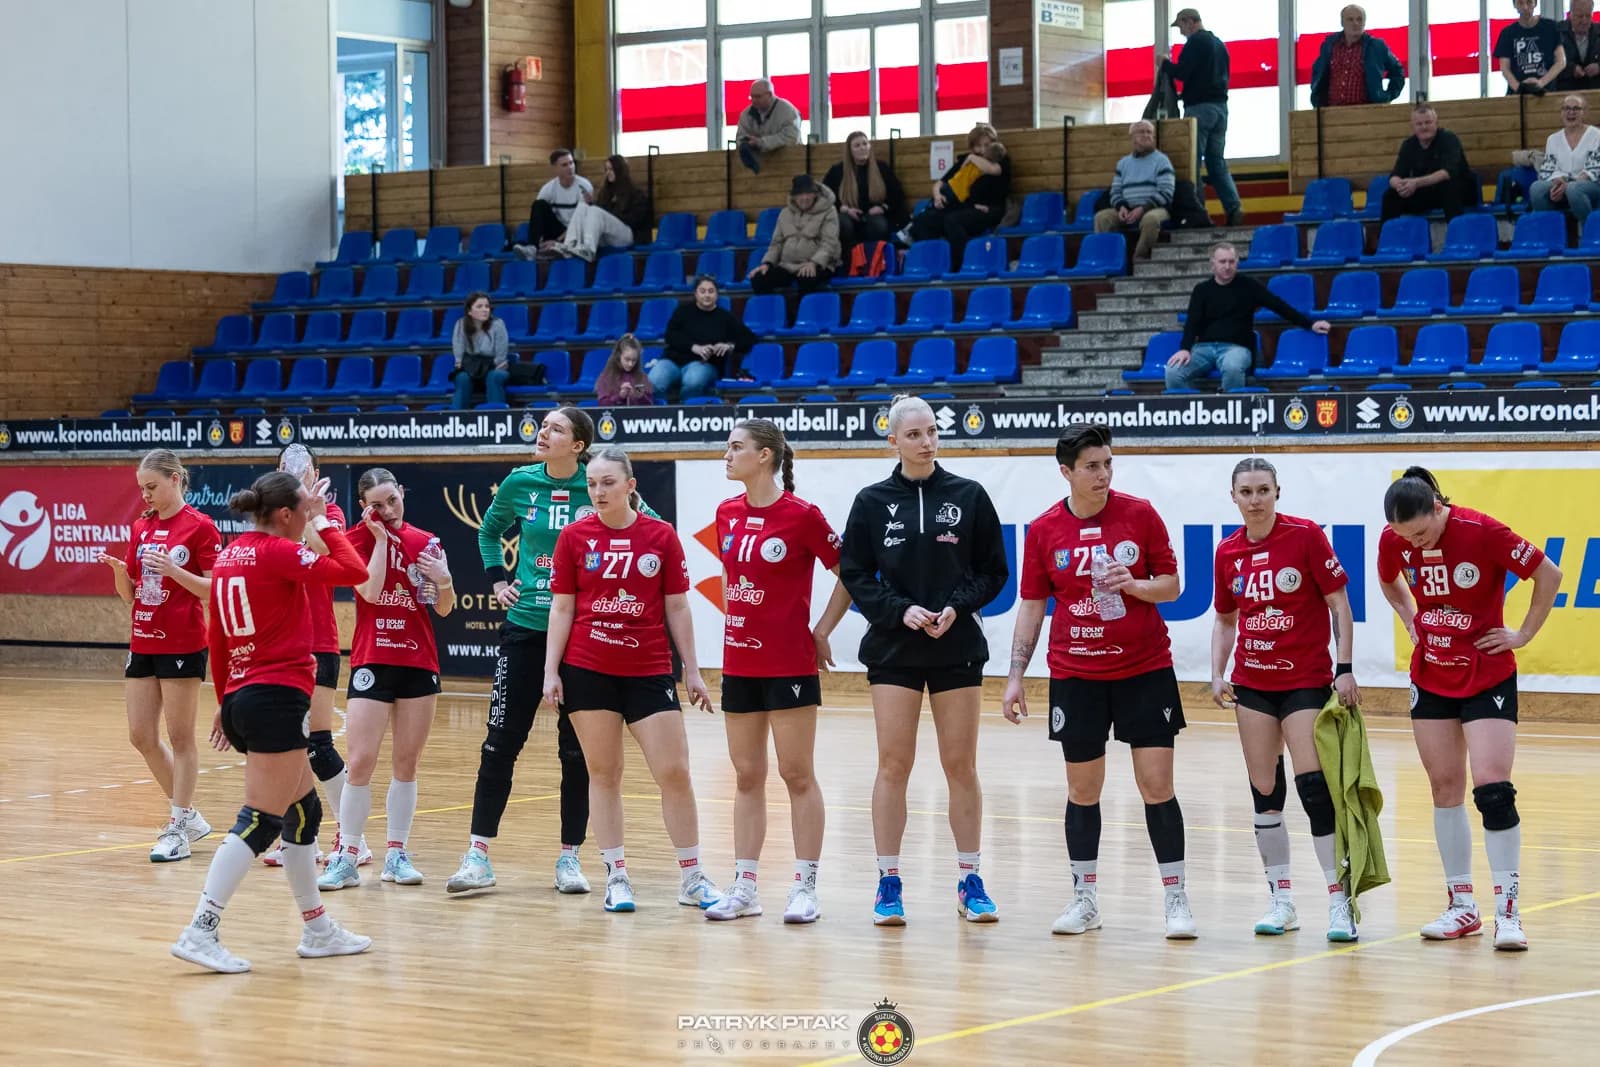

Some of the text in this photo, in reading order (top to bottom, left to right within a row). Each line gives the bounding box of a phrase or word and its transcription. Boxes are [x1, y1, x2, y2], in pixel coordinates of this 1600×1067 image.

[1041, 10, 1053, 22] B
[938, 158, 945, 170] B
[622, 407, 865, 437] www.koronndball.pl
[992, 399, 1275, 432] www.koronahandball.pl
[16, 421, 202, 447] www.koronahandball.pl
[301, 415, 512, 442] www.koronahandball.pl
[184, 482, 237, 506] entral
[53, 503, 87, 520] LIGA
[548, 504, 569, 529] 16
[54, 525, 131, 542] CENTRALN
[738, 534, 757, 562] 11
[536, 554, 552, 568] eis
[602, 551, 634, 579] 27
[1245, 569, 1274, 602] 49
[1420, 565, 1450, 596] 39
[216, 576, 256, 637] 10
[592, 597, 645, 617] eisberg
[1068, 597, 1101, 617] eisbe
[465, 620, 487, 629] HOTEL
[1246, 612, 1294, 631] eisberg
[1421, 608, 1472, 630] eisberg
